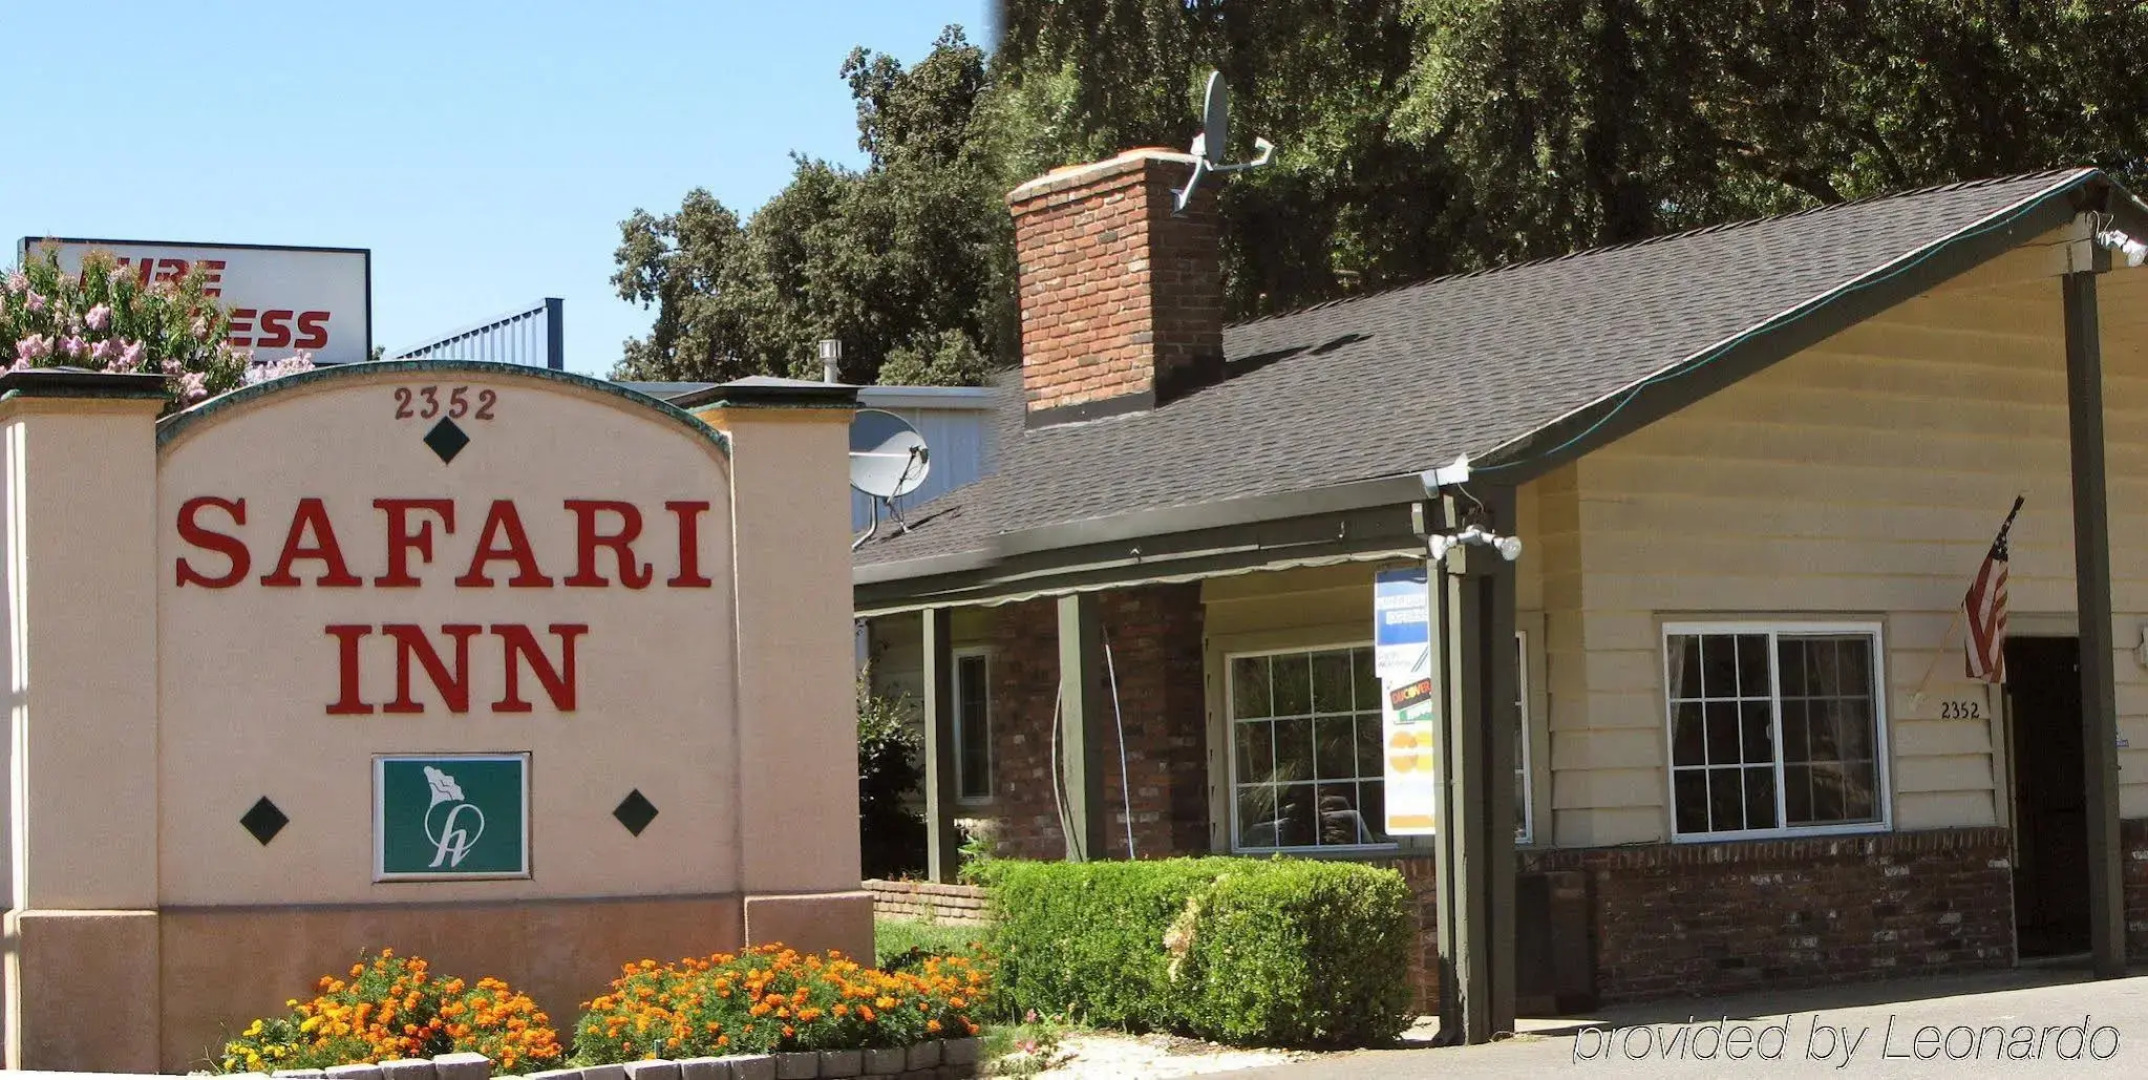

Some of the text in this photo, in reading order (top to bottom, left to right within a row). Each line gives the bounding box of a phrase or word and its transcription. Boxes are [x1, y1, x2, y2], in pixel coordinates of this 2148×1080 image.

[394, 386, 497, 421] 2352
[176, 496, 712, 590] SAFARI
[325, 624, 589, 715] INN
[1941, 701, 1980, 720] 2352
